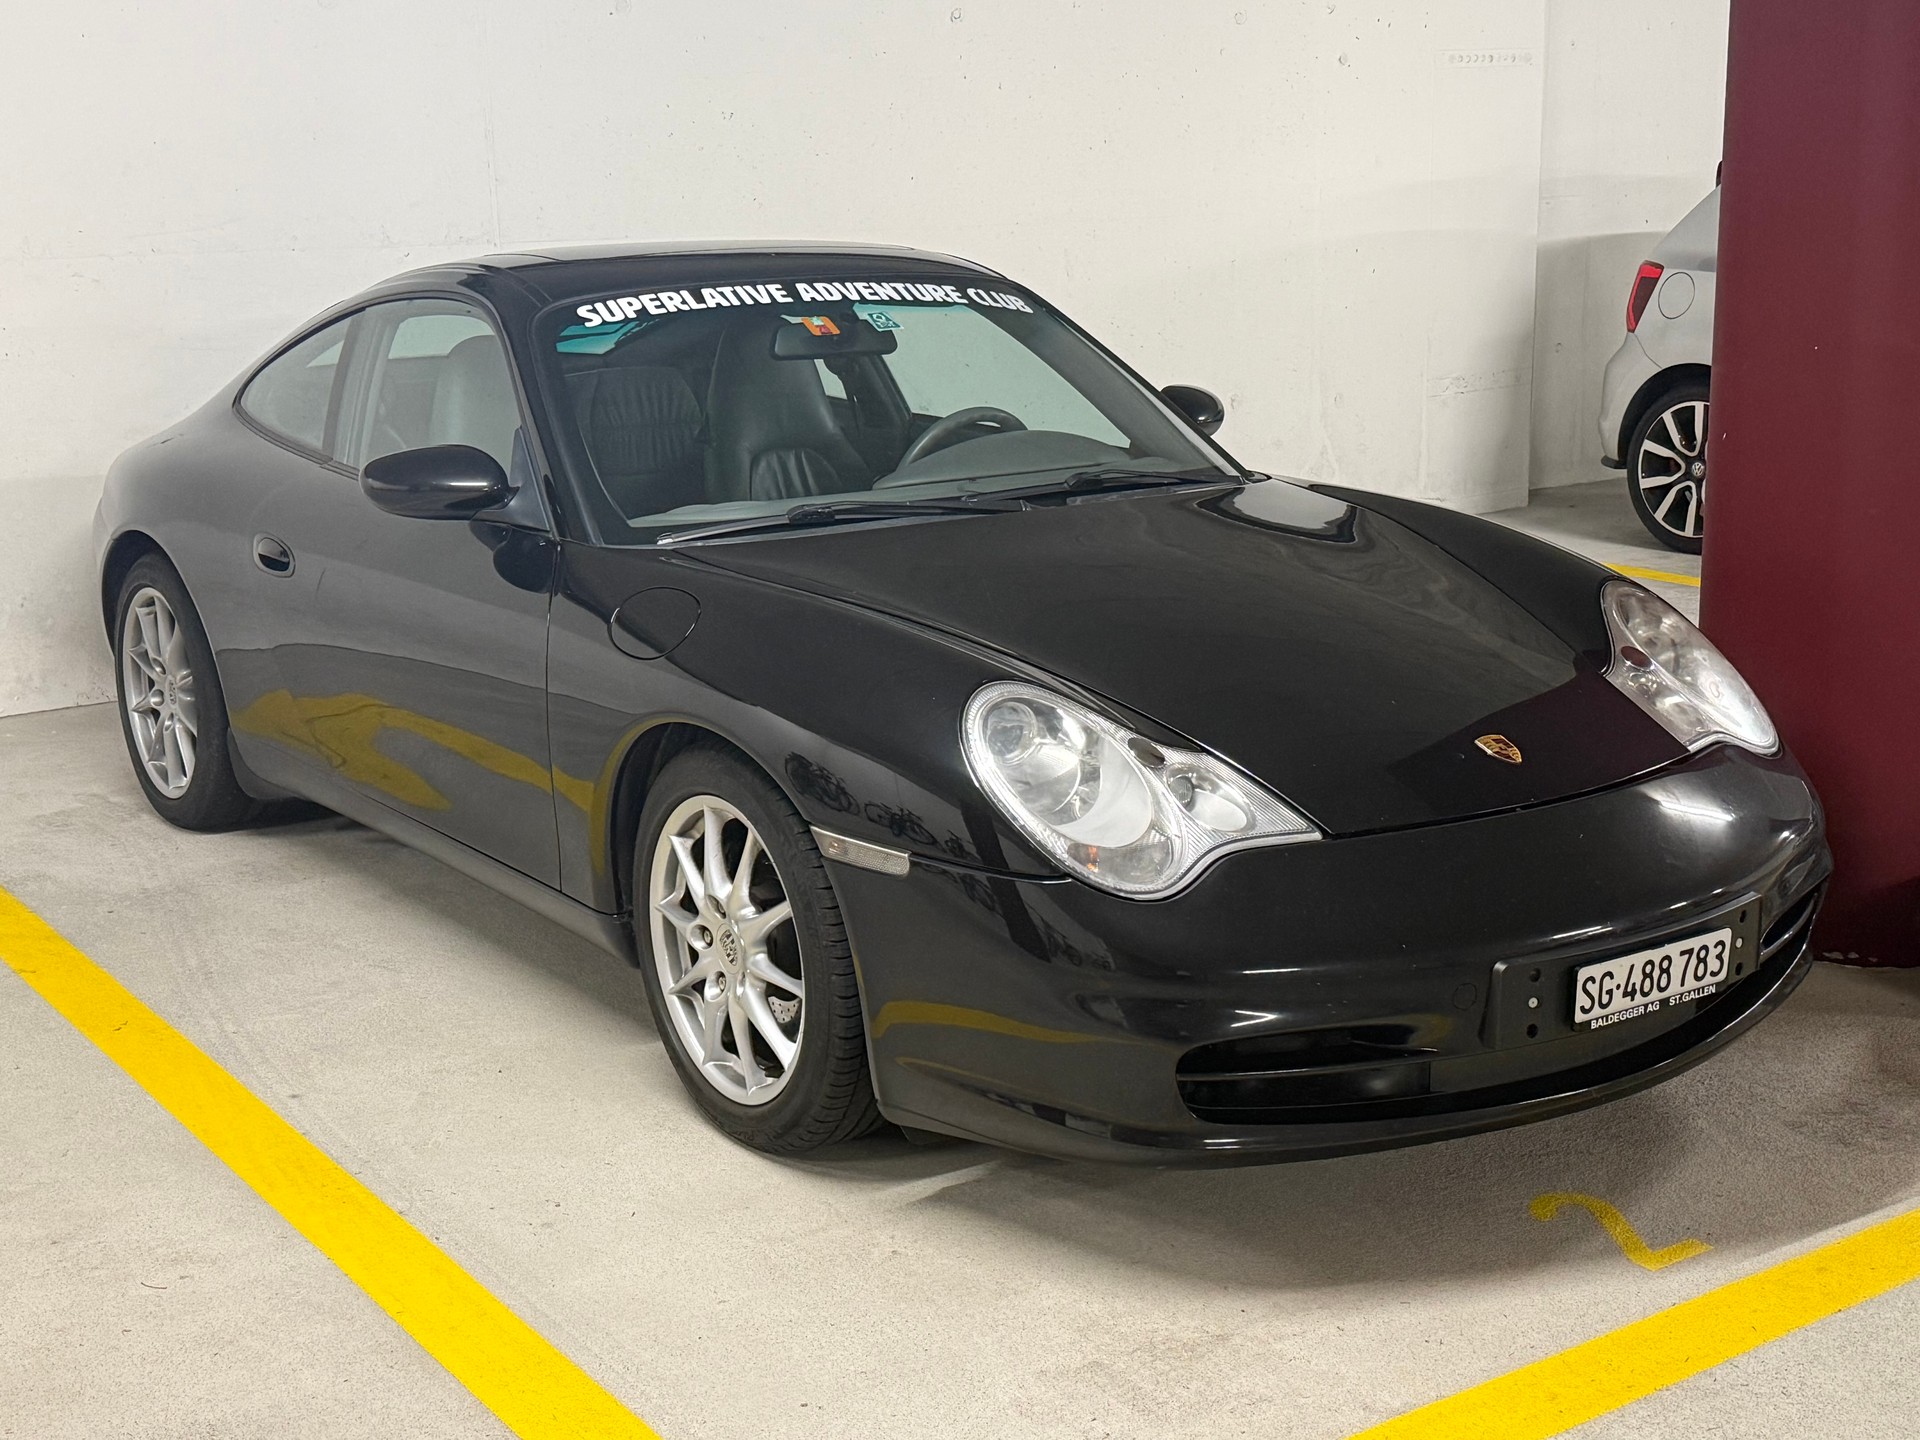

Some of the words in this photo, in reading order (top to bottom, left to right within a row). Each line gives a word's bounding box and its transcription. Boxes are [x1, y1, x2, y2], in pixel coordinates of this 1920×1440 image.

[576, 284, 794, 328] SUPERLATIVE
[795, 282, 969, 304] ADVENTURE
[966, 287, 1033, 313] CLUB
[1590, 1005, 1645, 1030] BALDEGGER
[1646, 1001, 1660, 1012] AG
[1528, 1191, 1715, 1272] 2
